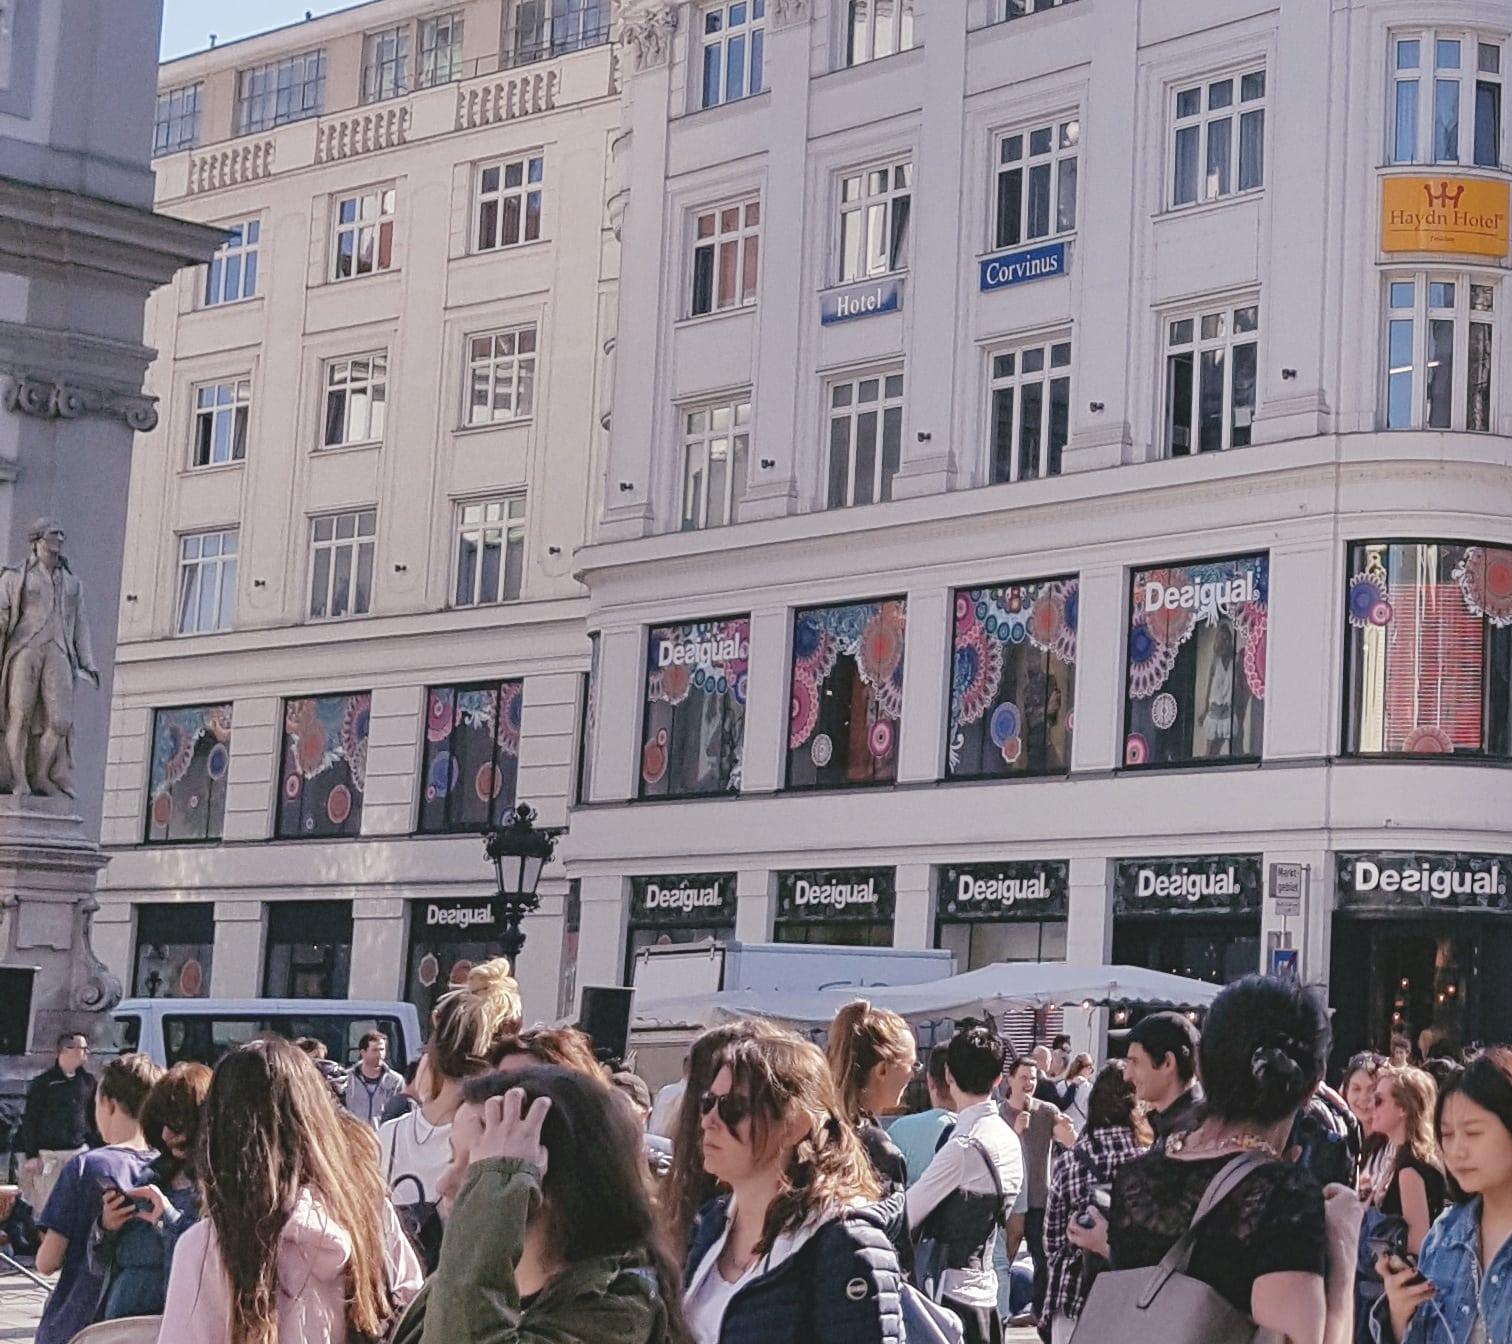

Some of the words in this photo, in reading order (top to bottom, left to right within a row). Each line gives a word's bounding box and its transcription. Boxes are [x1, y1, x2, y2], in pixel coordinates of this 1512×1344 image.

[1389, 209, 1448, 231] Haydn
[1453, 210, 1500, 229] Hotel
[986, 254, 1058, 284] Corvinus
[837, 287, 882, 317] Hotel
